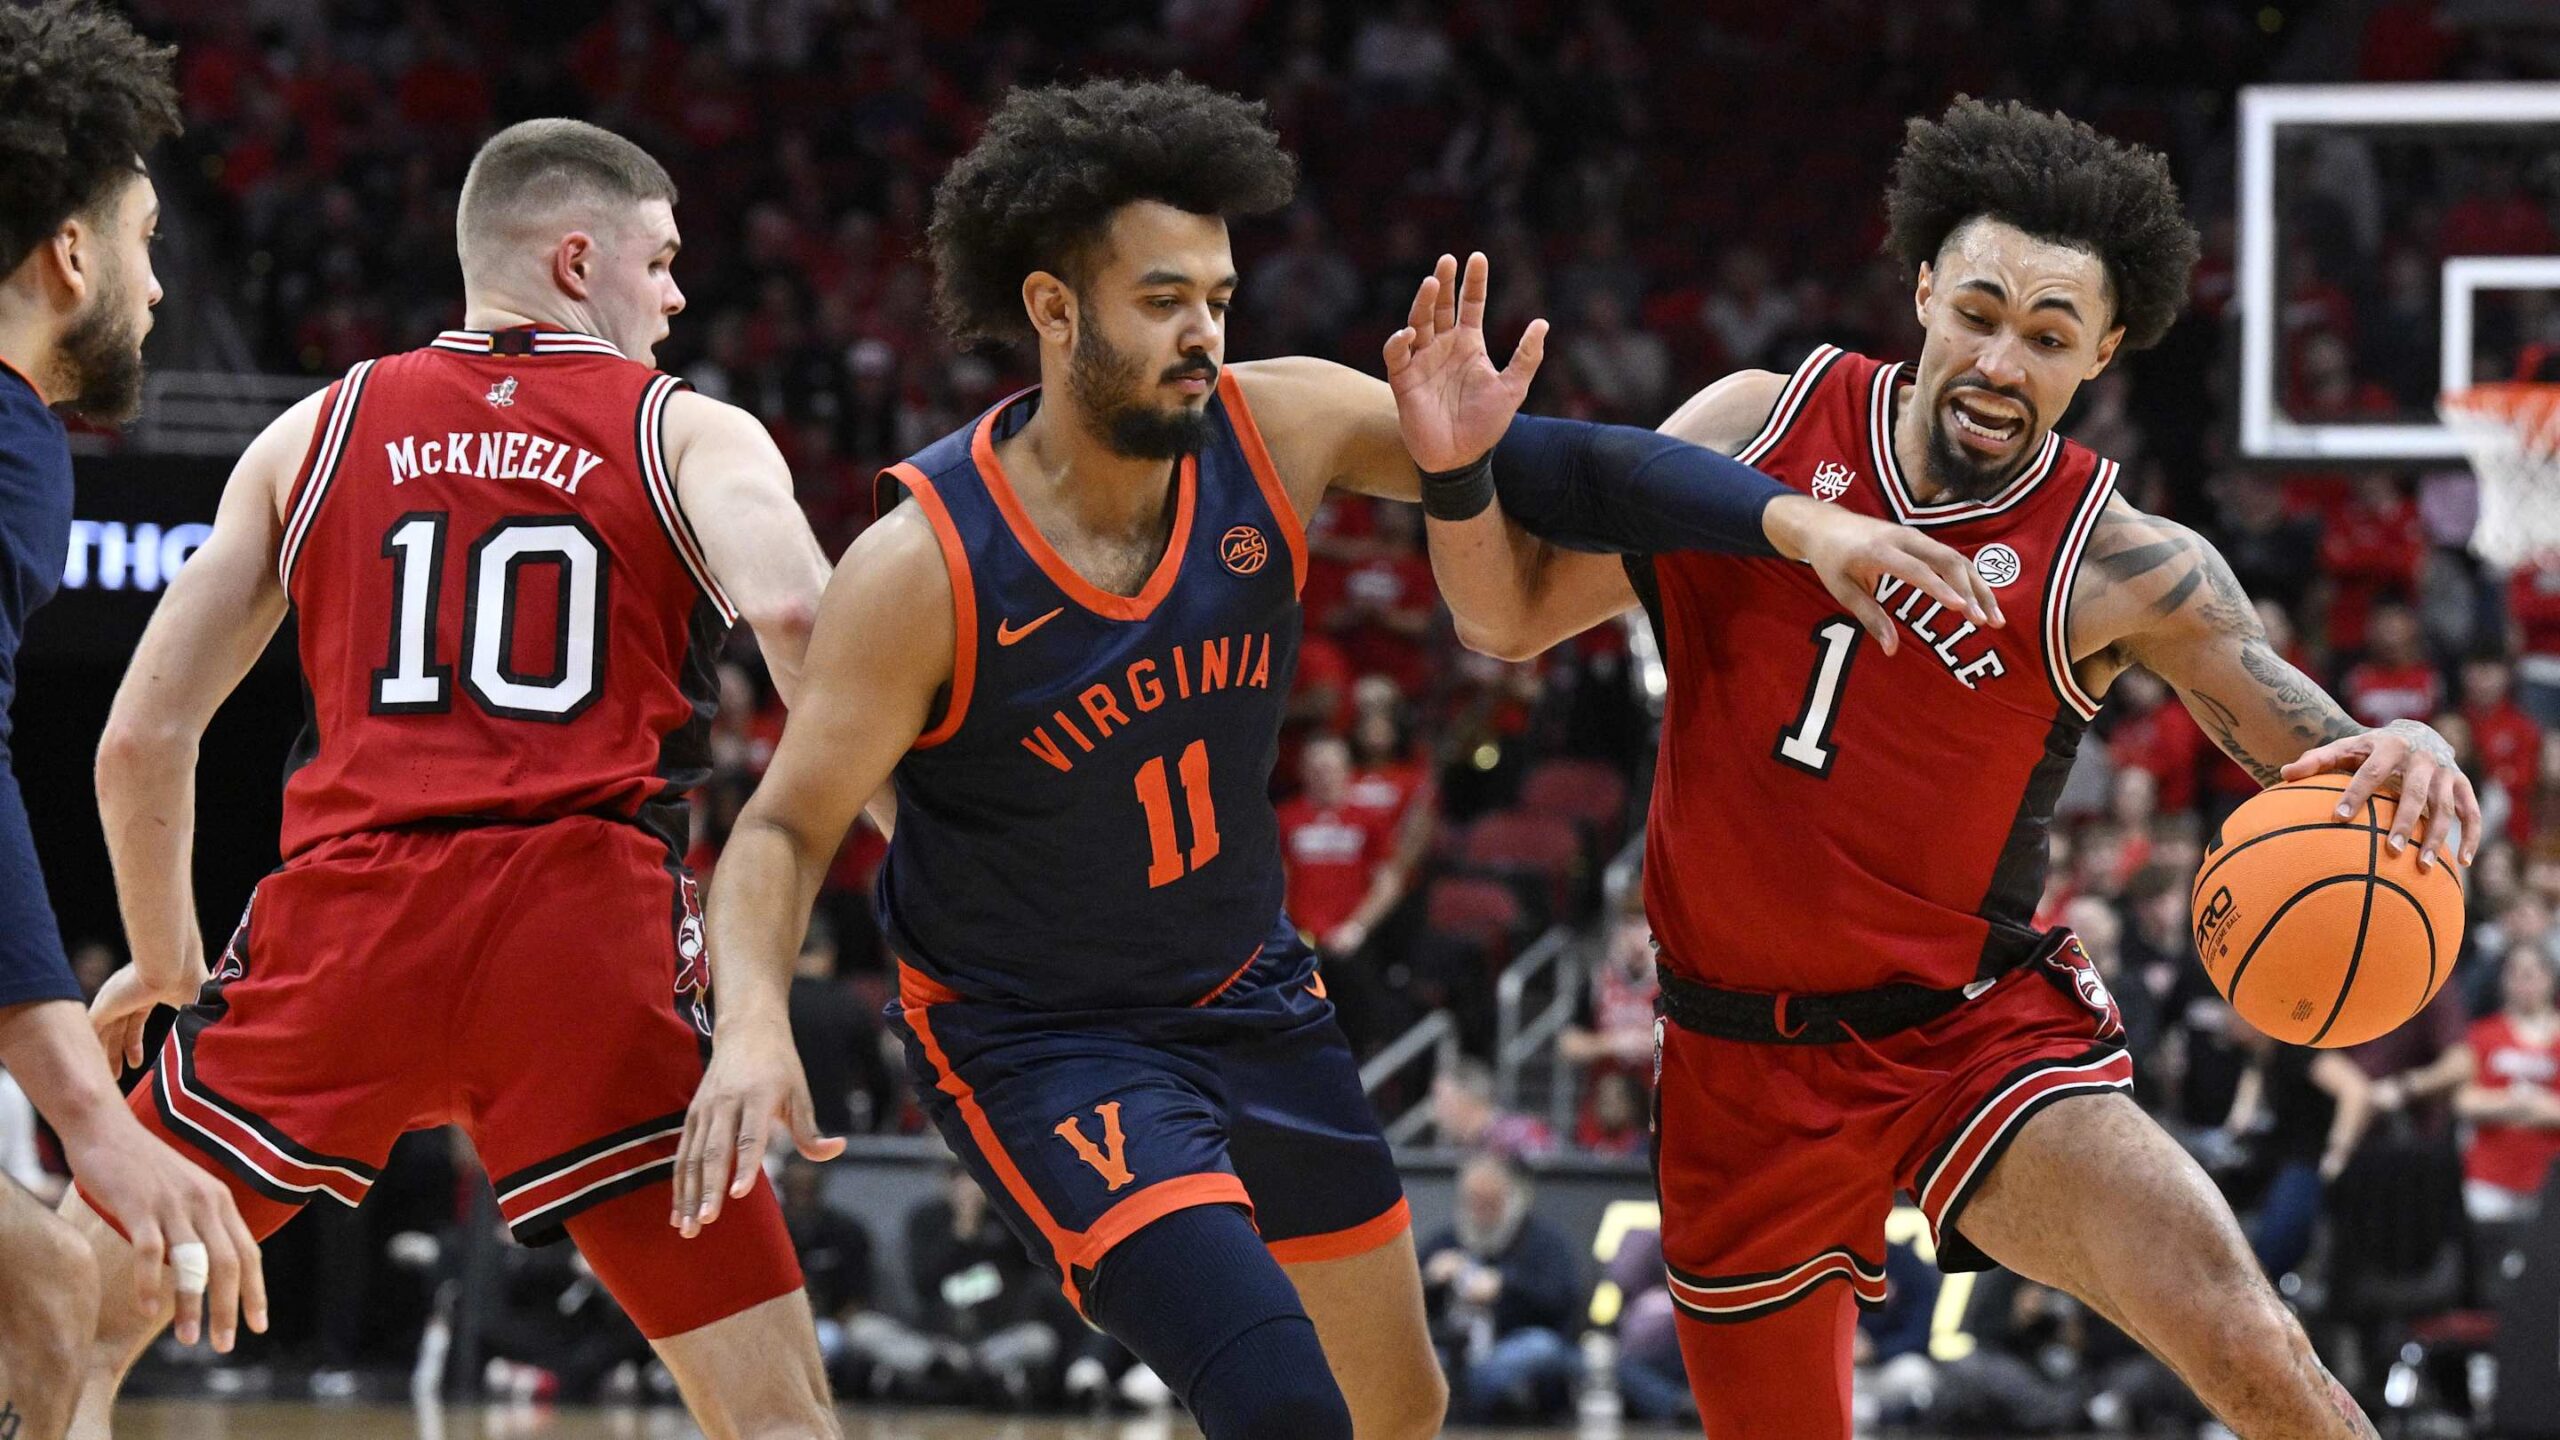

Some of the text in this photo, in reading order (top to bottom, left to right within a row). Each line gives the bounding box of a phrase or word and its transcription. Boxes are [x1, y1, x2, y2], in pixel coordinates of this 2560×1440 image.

[385, 432, 603, 495] McKNEELY
[1228, 534, 1264, 558] ACC
[1983, 558, 2016, 574] ACC
[372, 513, 608, 723] 10
[1020, 632, 1270, 773] VIRGINIA
[1777, 617, 1858, 775] 1
[1133, 738, 1220, 889] 11
[2196, 885, 2232, 960] PRO
[2225, 911, 2242, 930] BALL
[1054, 1101, 1136, 1191] V
